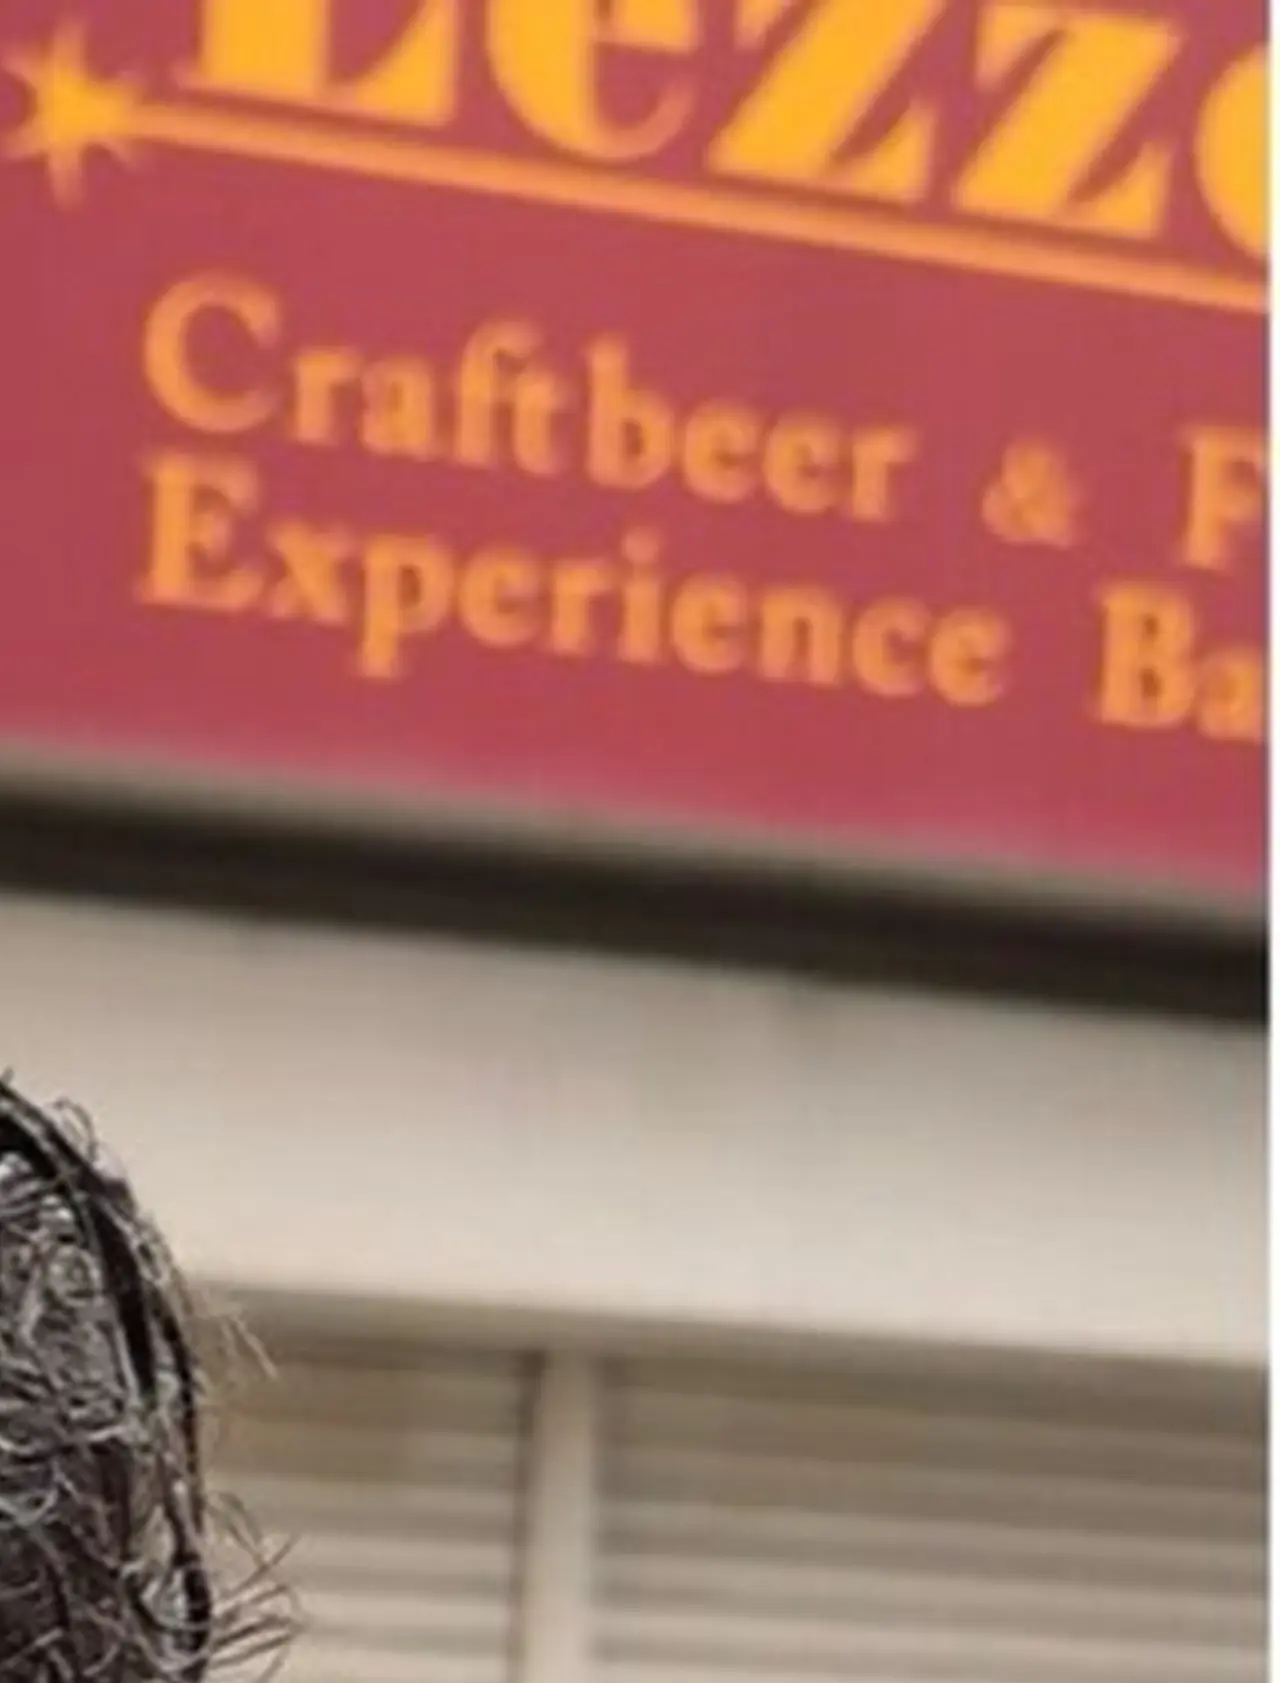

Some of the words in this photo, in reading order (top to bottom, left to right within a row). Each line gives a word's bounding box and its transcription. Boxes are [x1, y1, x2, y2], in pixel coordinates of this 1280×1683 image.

[142, 272, 918, 525] Craftbeer
[980, 438, 1078, 548] &
[138, 451, 1012, 707] Experience
